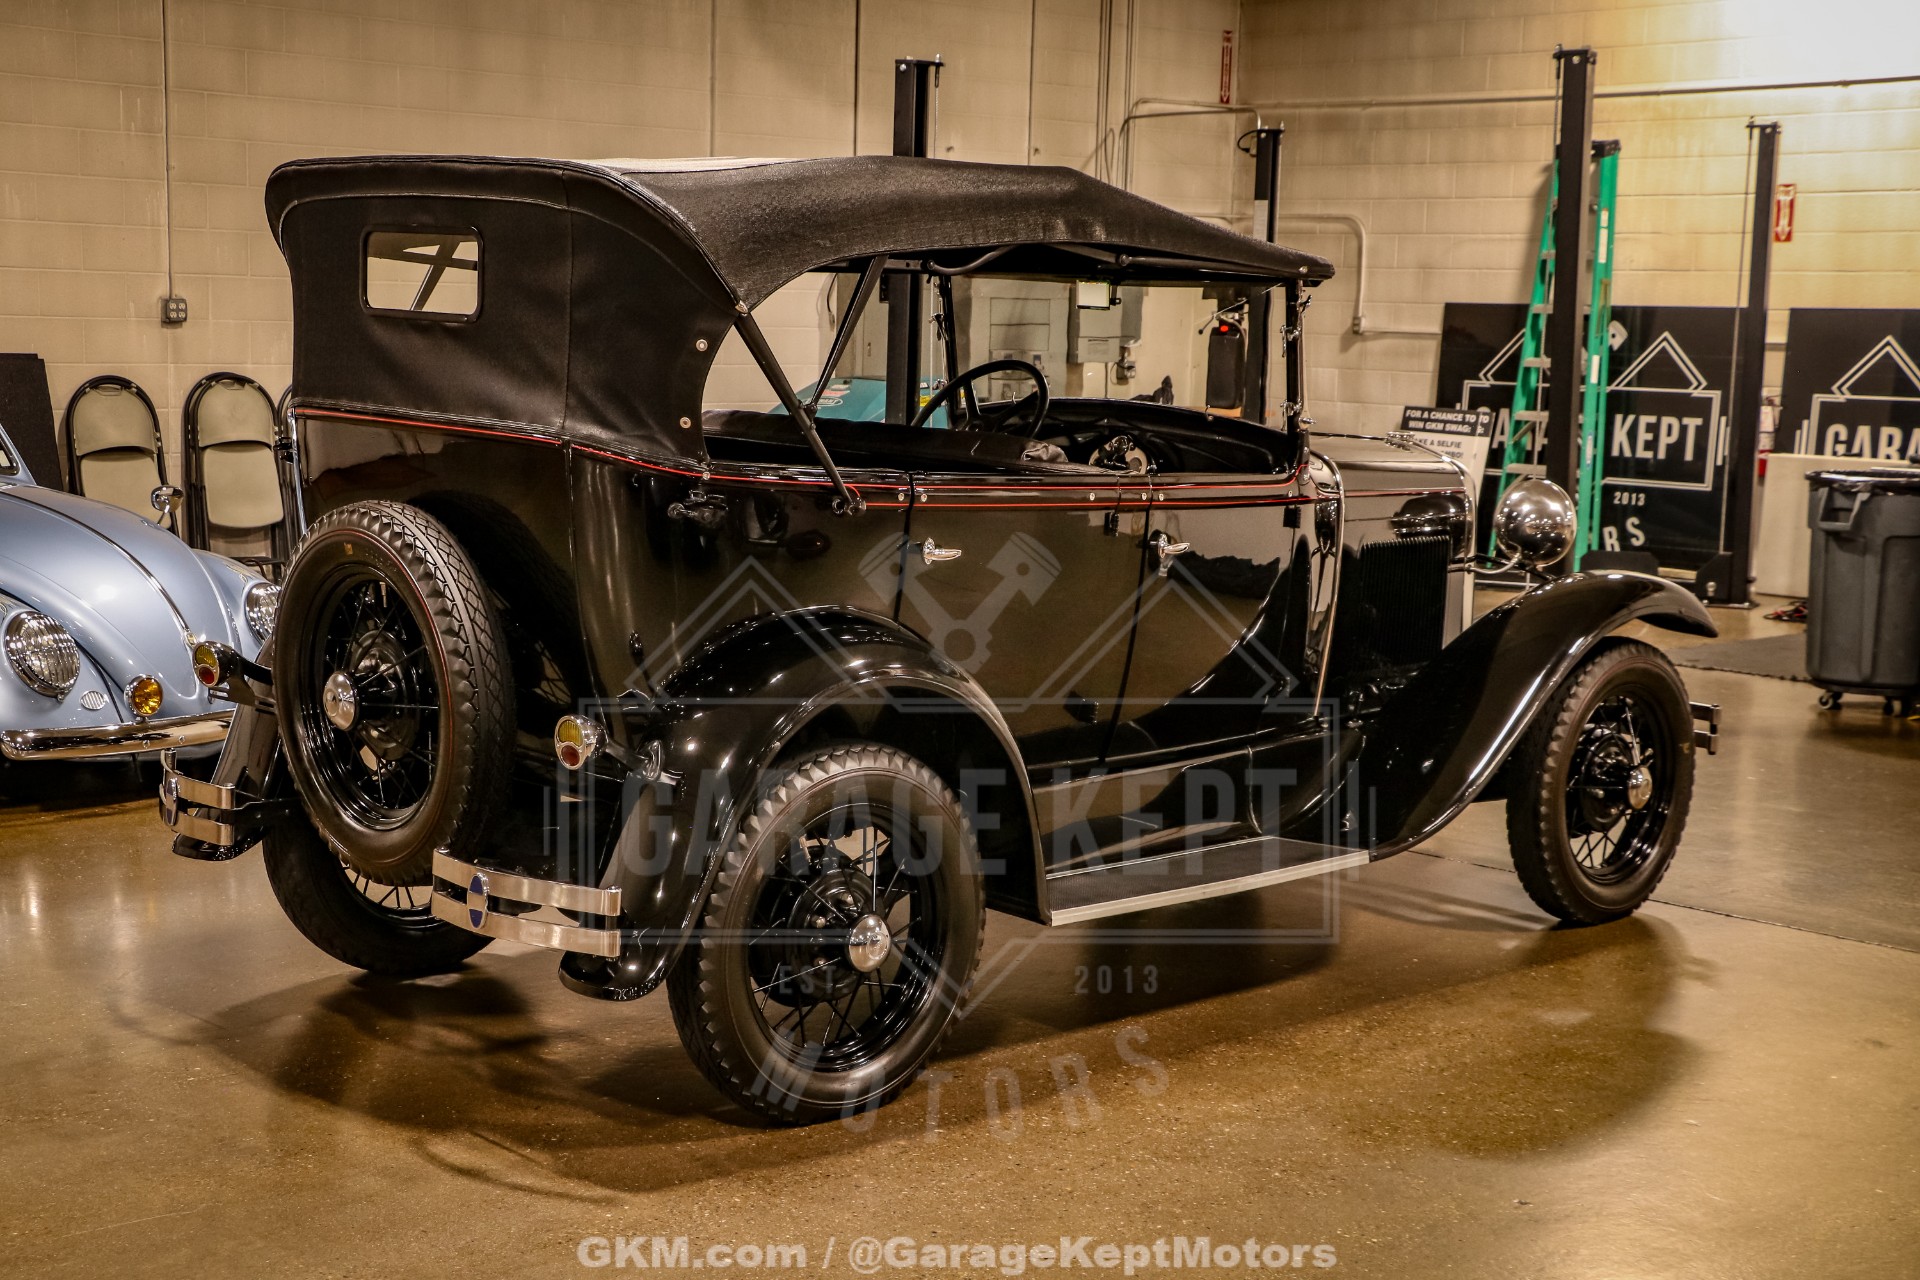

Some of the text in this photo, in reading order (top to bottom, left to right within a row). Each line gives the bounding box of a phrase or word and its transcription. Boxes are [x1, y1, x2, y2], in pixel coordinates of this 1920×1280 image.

[1405, 410, 1476, 422] FOR A CHANCE TO
[1408, 420, 1424, 429] WIN
[1425, 422, 1444, 431] GKM
[1611, 414, 1703, 461] KEPT
[1437, 440, 1462, 449] SELFIE
[1613, 491, 1646, 507] 2013
